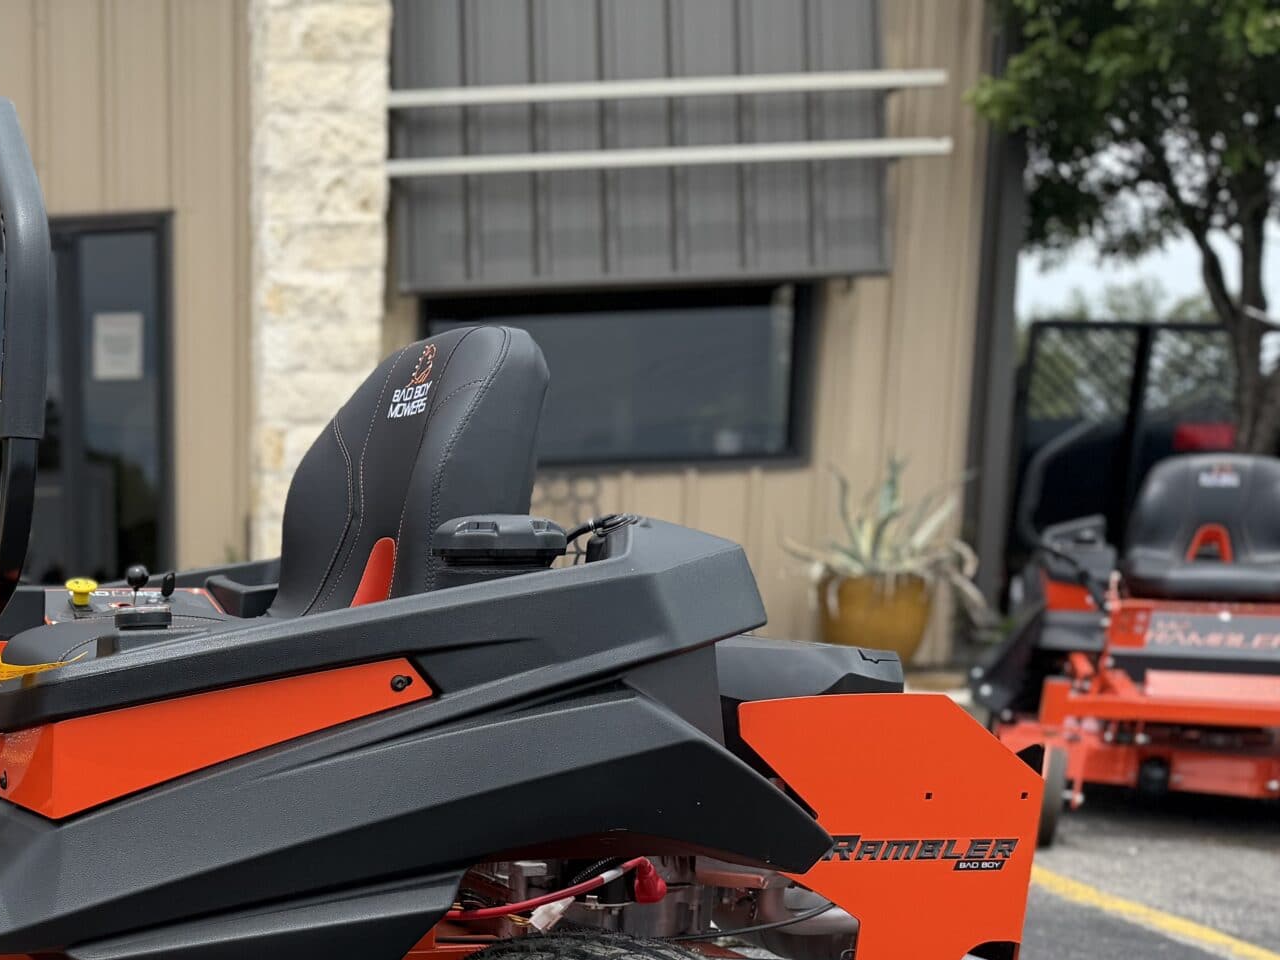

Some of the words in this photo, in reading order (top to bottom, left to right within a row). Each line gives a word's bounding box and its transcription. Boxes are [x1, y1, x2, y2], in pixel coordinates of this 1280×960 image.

[392, 387, 414, 402] BAD
[413, 380, 433, 399] BOY
[387, 397, 427, 419] MOWERS
[959, 861, 979, 869] BAD
[981, 861, 1001, 869] BOY
